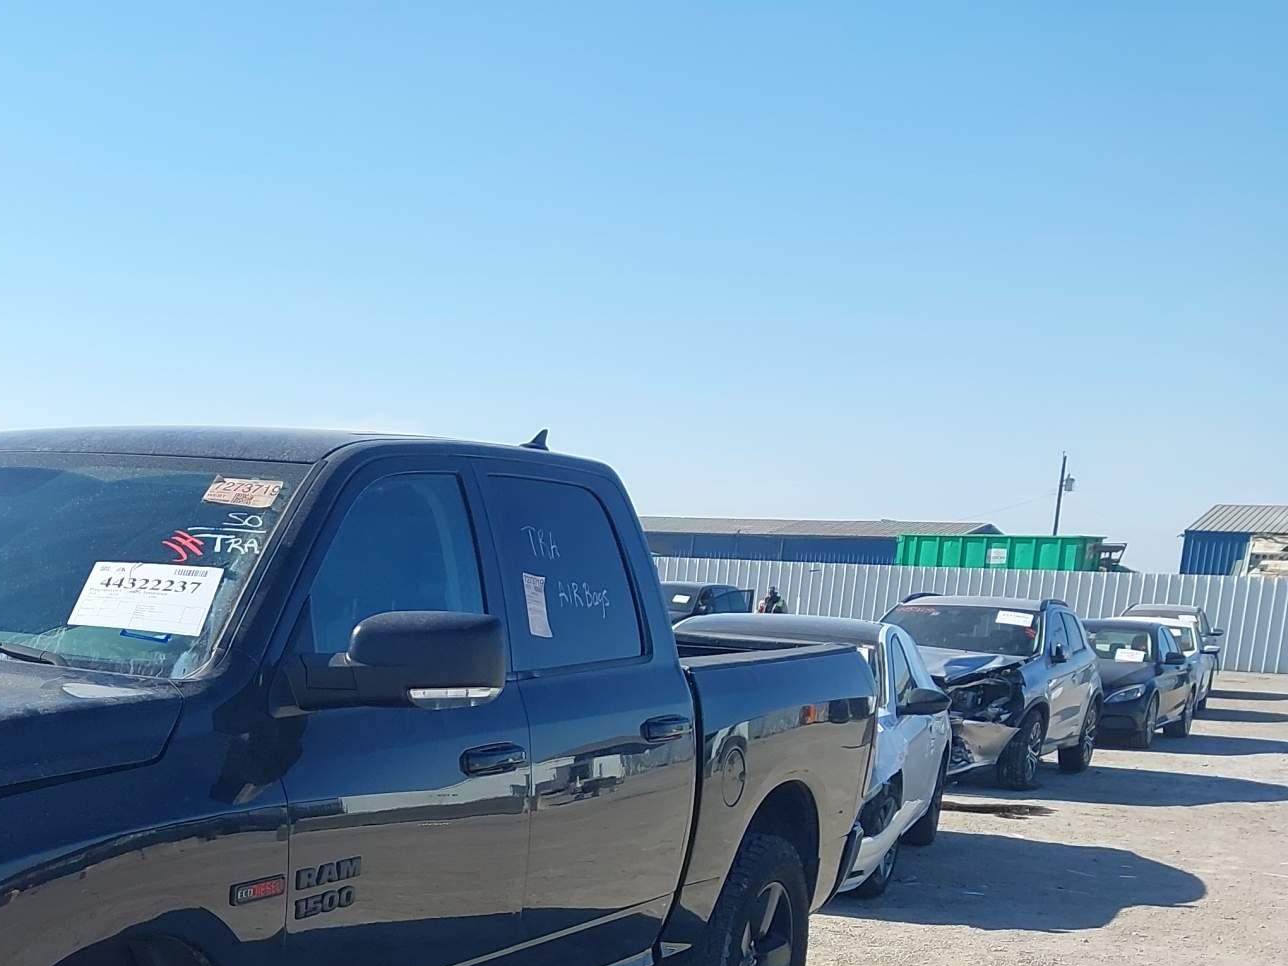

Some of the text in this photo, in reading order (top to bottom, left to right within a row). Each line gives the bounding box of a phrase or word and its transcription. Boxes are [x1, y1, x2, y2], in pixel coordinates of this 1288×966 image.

[215, 480, 281, 497] 7273719
[100, 576, 202, 594] 44322237
[295, 856, 362, 890] RAM
[295, 885, 356, 920] 1500
